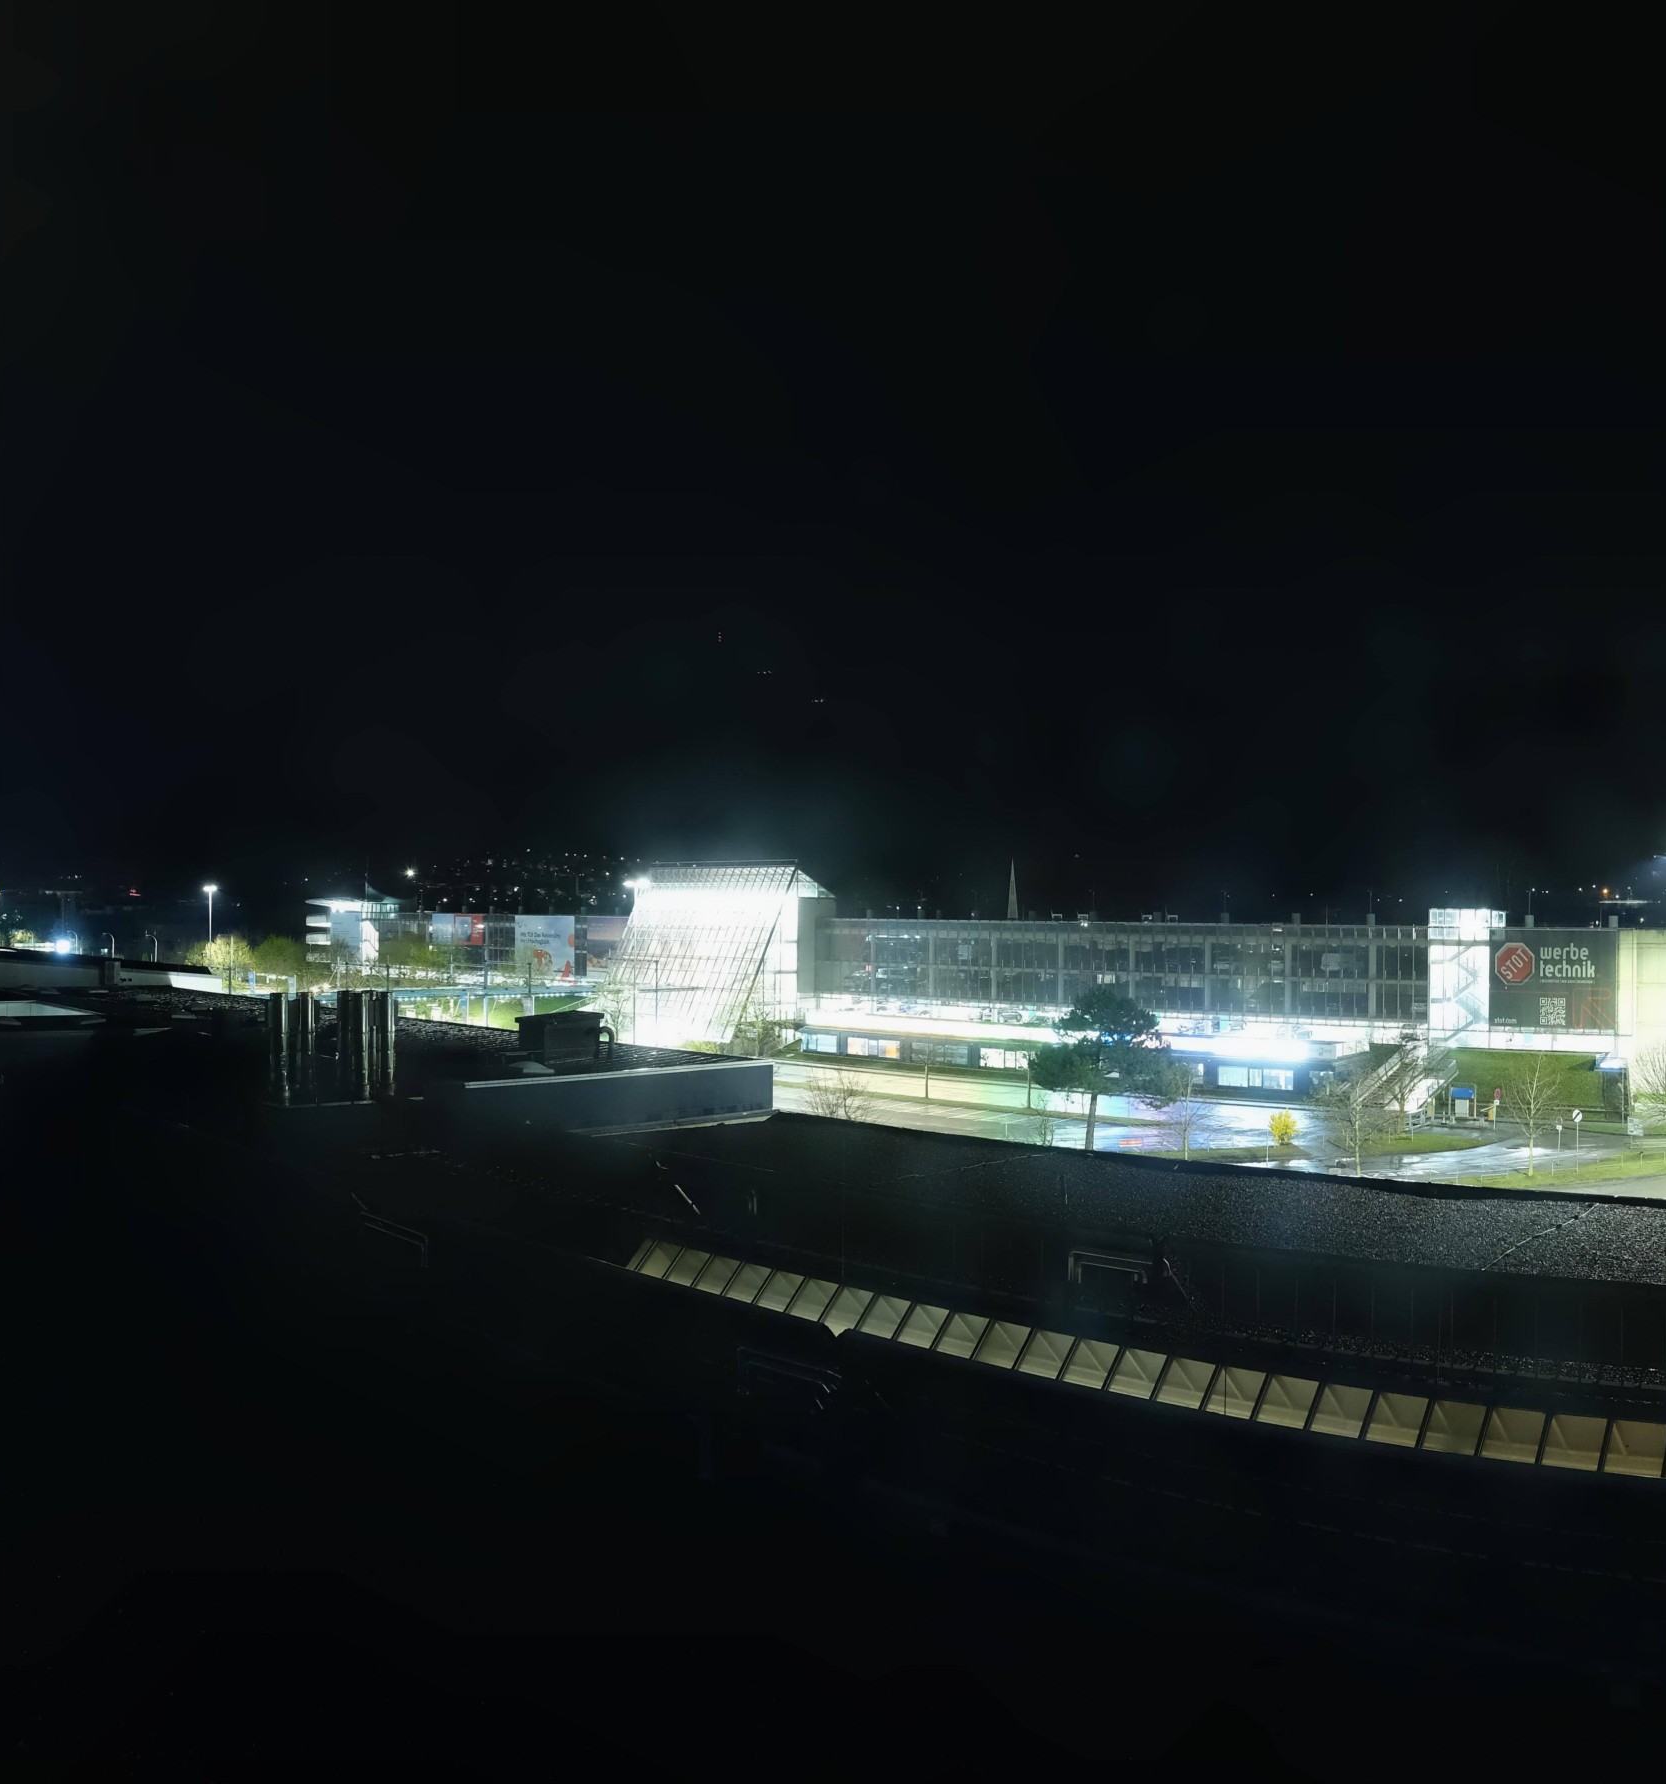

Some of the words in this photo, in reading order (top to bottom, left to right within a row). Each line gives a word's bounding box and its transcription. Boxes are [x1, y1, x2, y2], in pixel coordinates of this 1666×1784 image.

[1540, 942, 1589, 960] werbe
[1500, 948, 1529, 980] STOT
[1540, 960, 1596, 978] technik
